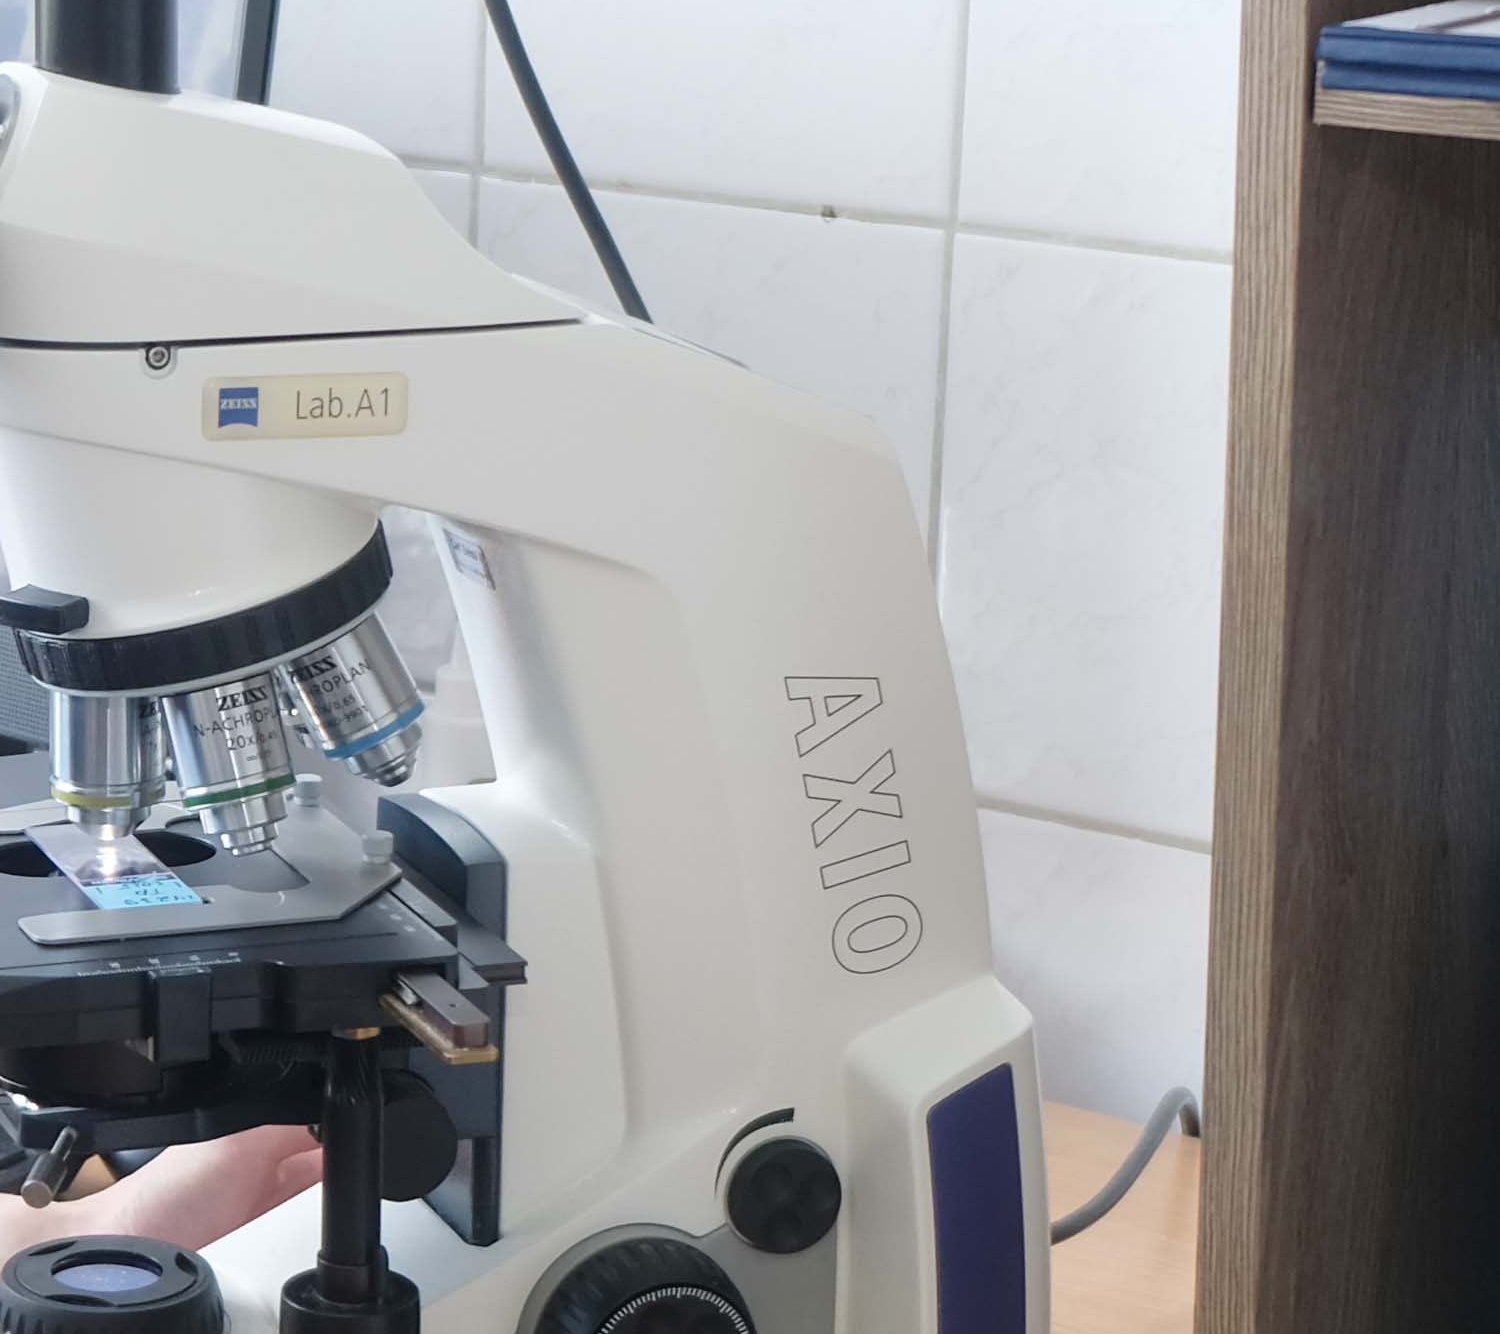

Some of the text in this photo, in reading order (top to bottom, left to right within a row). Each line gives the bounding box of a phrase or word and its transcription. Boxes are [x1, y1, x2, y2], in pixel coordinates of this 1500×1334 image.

[220, 386, 390, 420] ZEISS Lab.A1
[217, 685, 269, 712] ZEISS
[783, 675, 924, 975] AXIO
